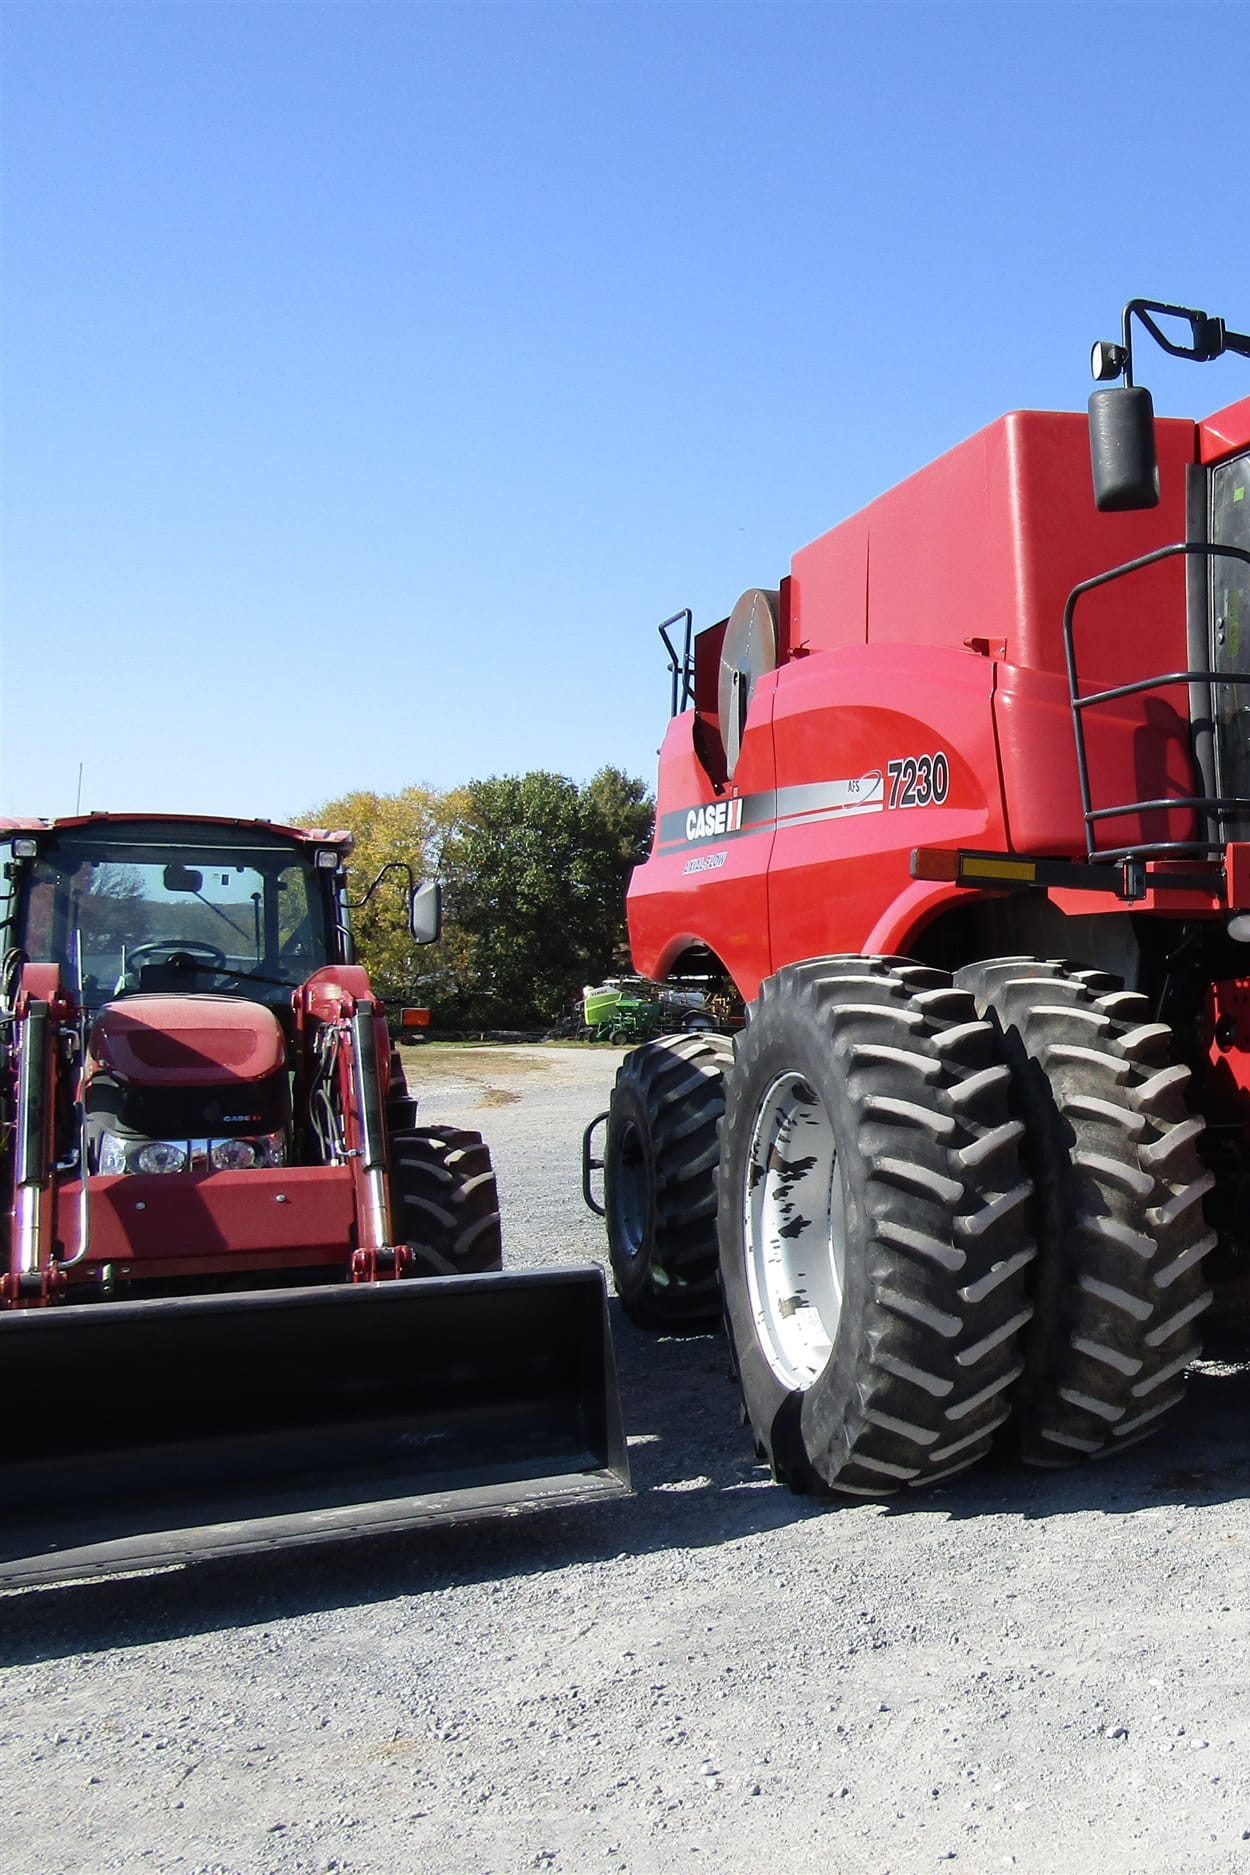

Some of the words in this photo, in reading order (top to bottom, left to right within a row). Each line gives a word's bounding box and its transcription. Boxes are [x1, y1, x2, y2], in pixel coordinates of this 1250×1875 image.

[847, 779, 861, 793] AFS
[887, 751, 950, 810] 7230
[686, 803, 727, 841] CASE
